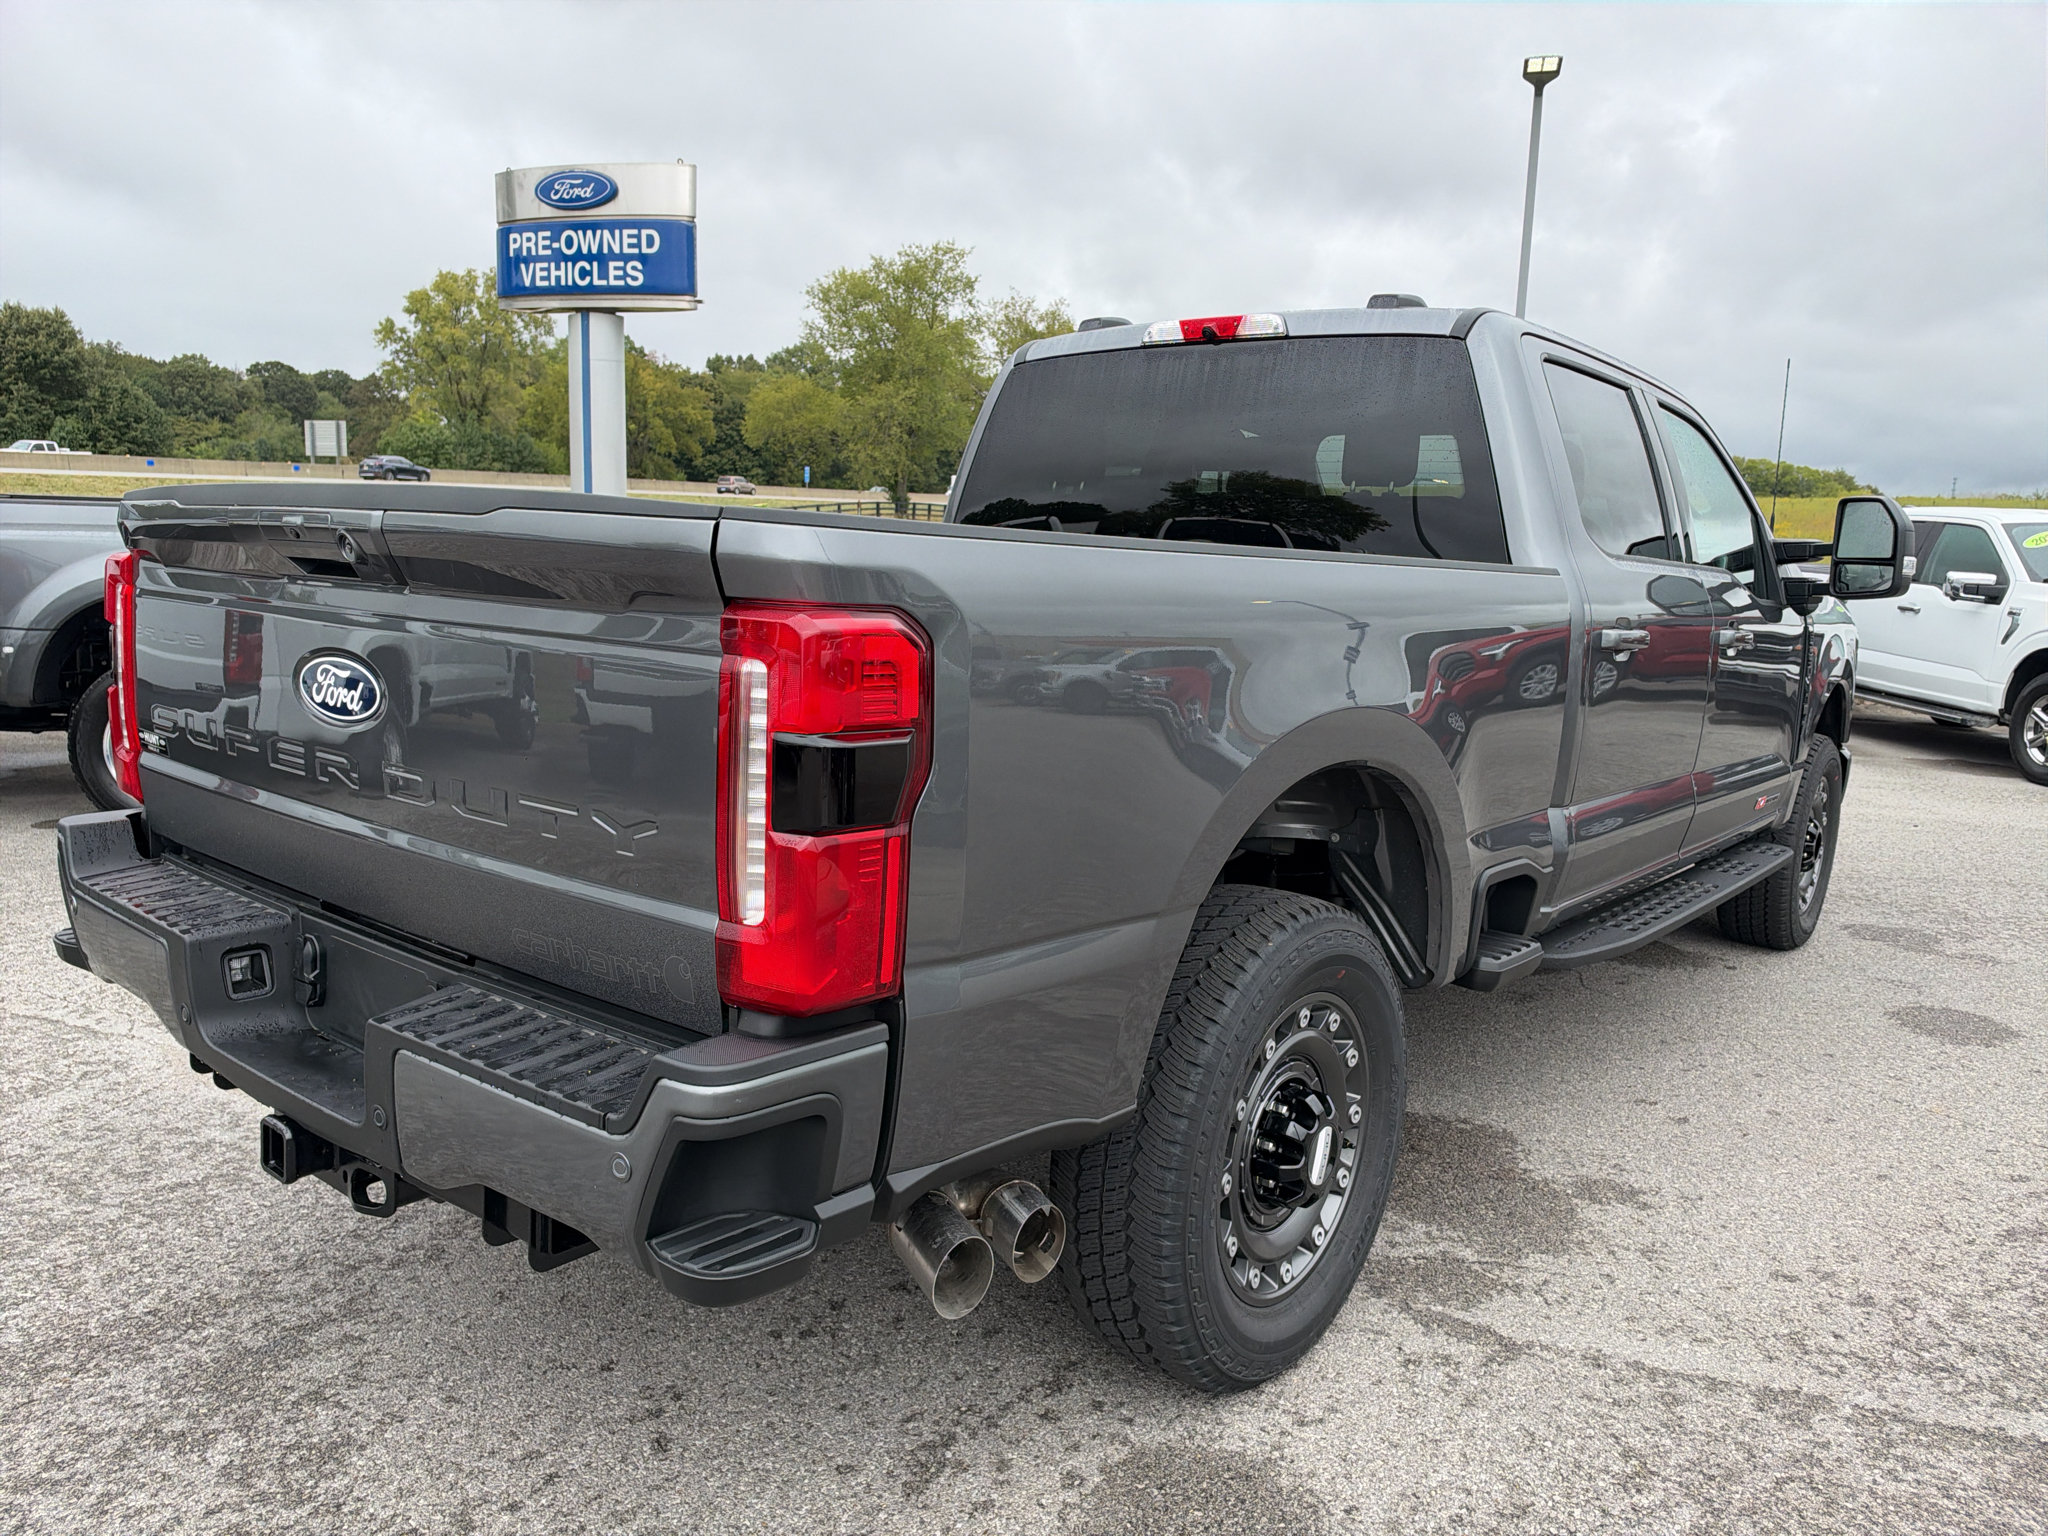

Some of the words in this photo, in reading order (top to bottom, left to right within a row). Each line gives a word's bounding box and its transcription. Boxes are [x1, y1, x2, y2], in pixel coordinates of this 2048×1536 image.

[550, 178, 596, 201] Ford
[508, 228, 661, 257] PRE-OWNED
[519, 260, 645, 287] VEHICLES
[312, 663, 365, 712] Ford
[150, 703, 361, 791] SUPER
[381, 763, 659, 857] DUTY
[511, 927, 661, 994] carhartt
